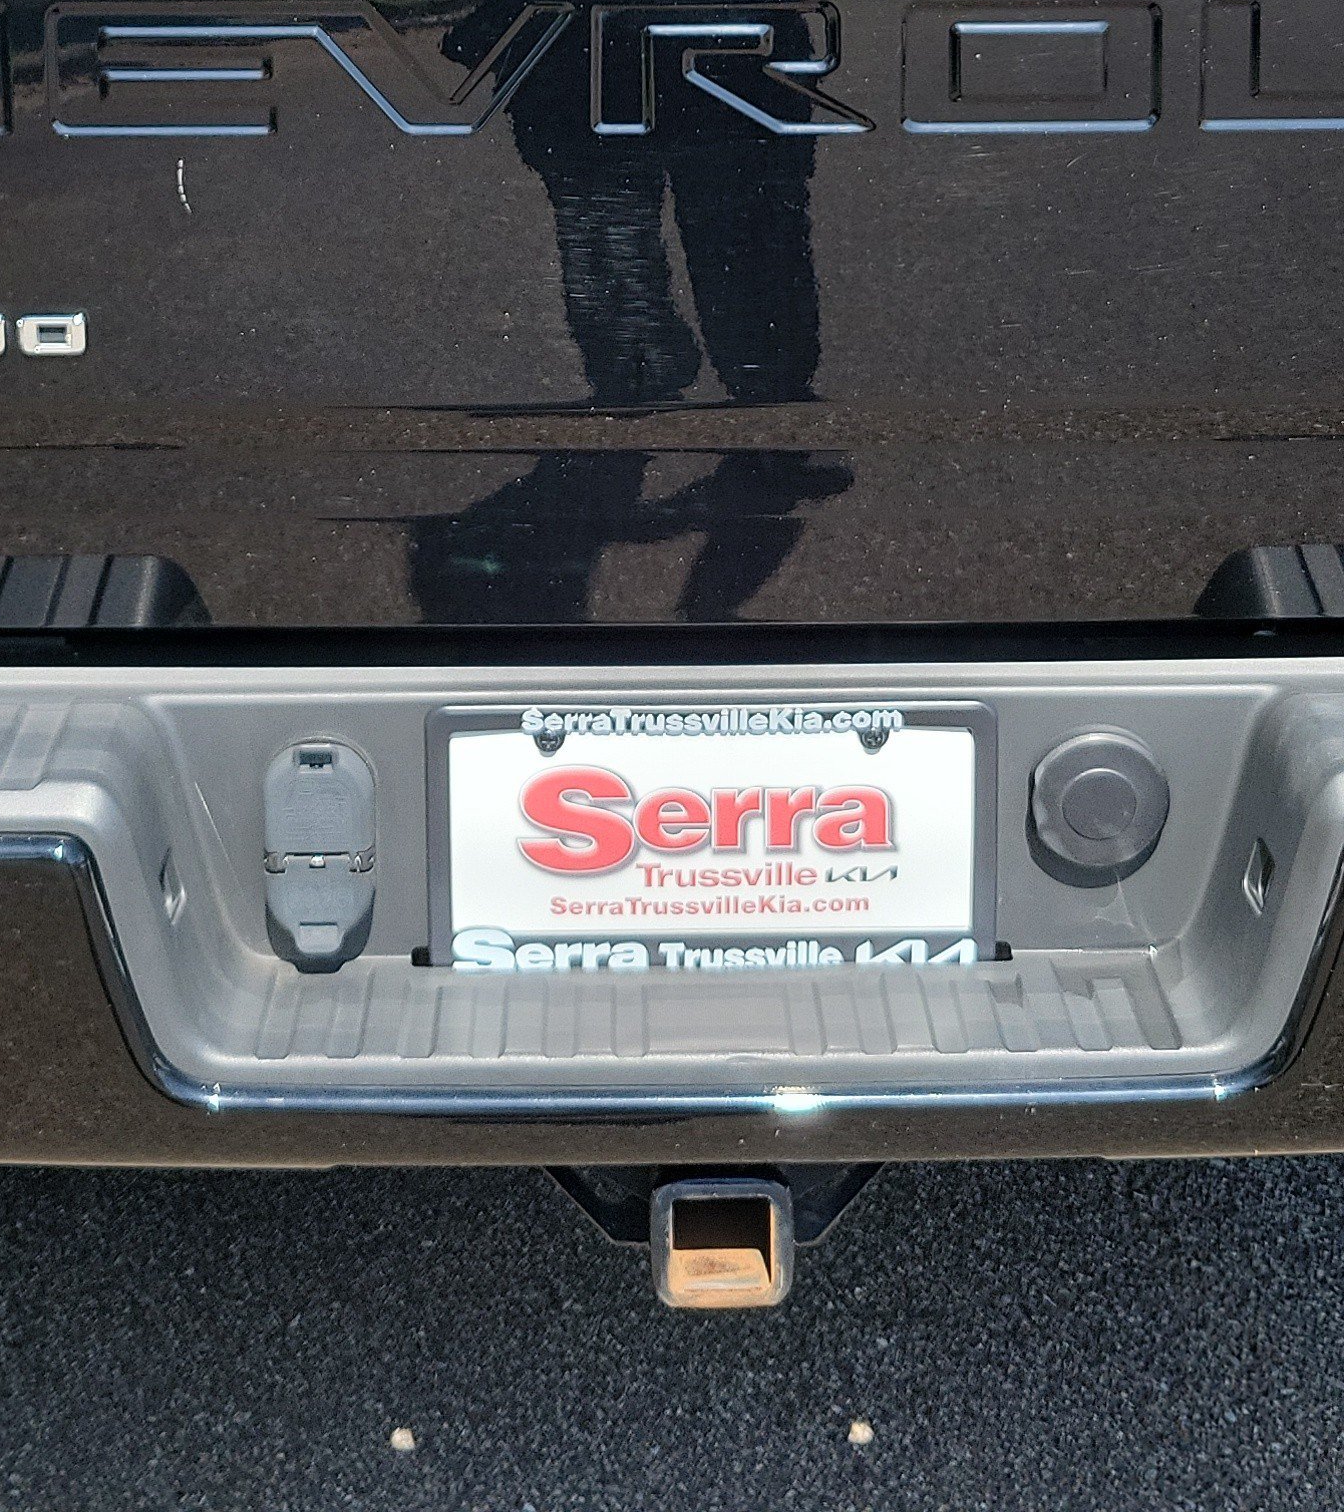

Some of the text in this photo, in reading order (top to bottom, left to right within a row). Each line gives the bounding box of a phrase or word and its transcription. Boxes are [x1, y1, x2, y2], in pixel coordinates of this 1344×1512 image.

[521, 707, 905, 735] SerraTrussvilleKia.com
[516, 763, 897, 878] Serra
[635, 861, 819, 888] Trussville
[549, 894, 871, 917] SerraTrussvilleKia.com
[452, 926, 651, 970] Serra
[657, 939, 846, 968] Trussville
